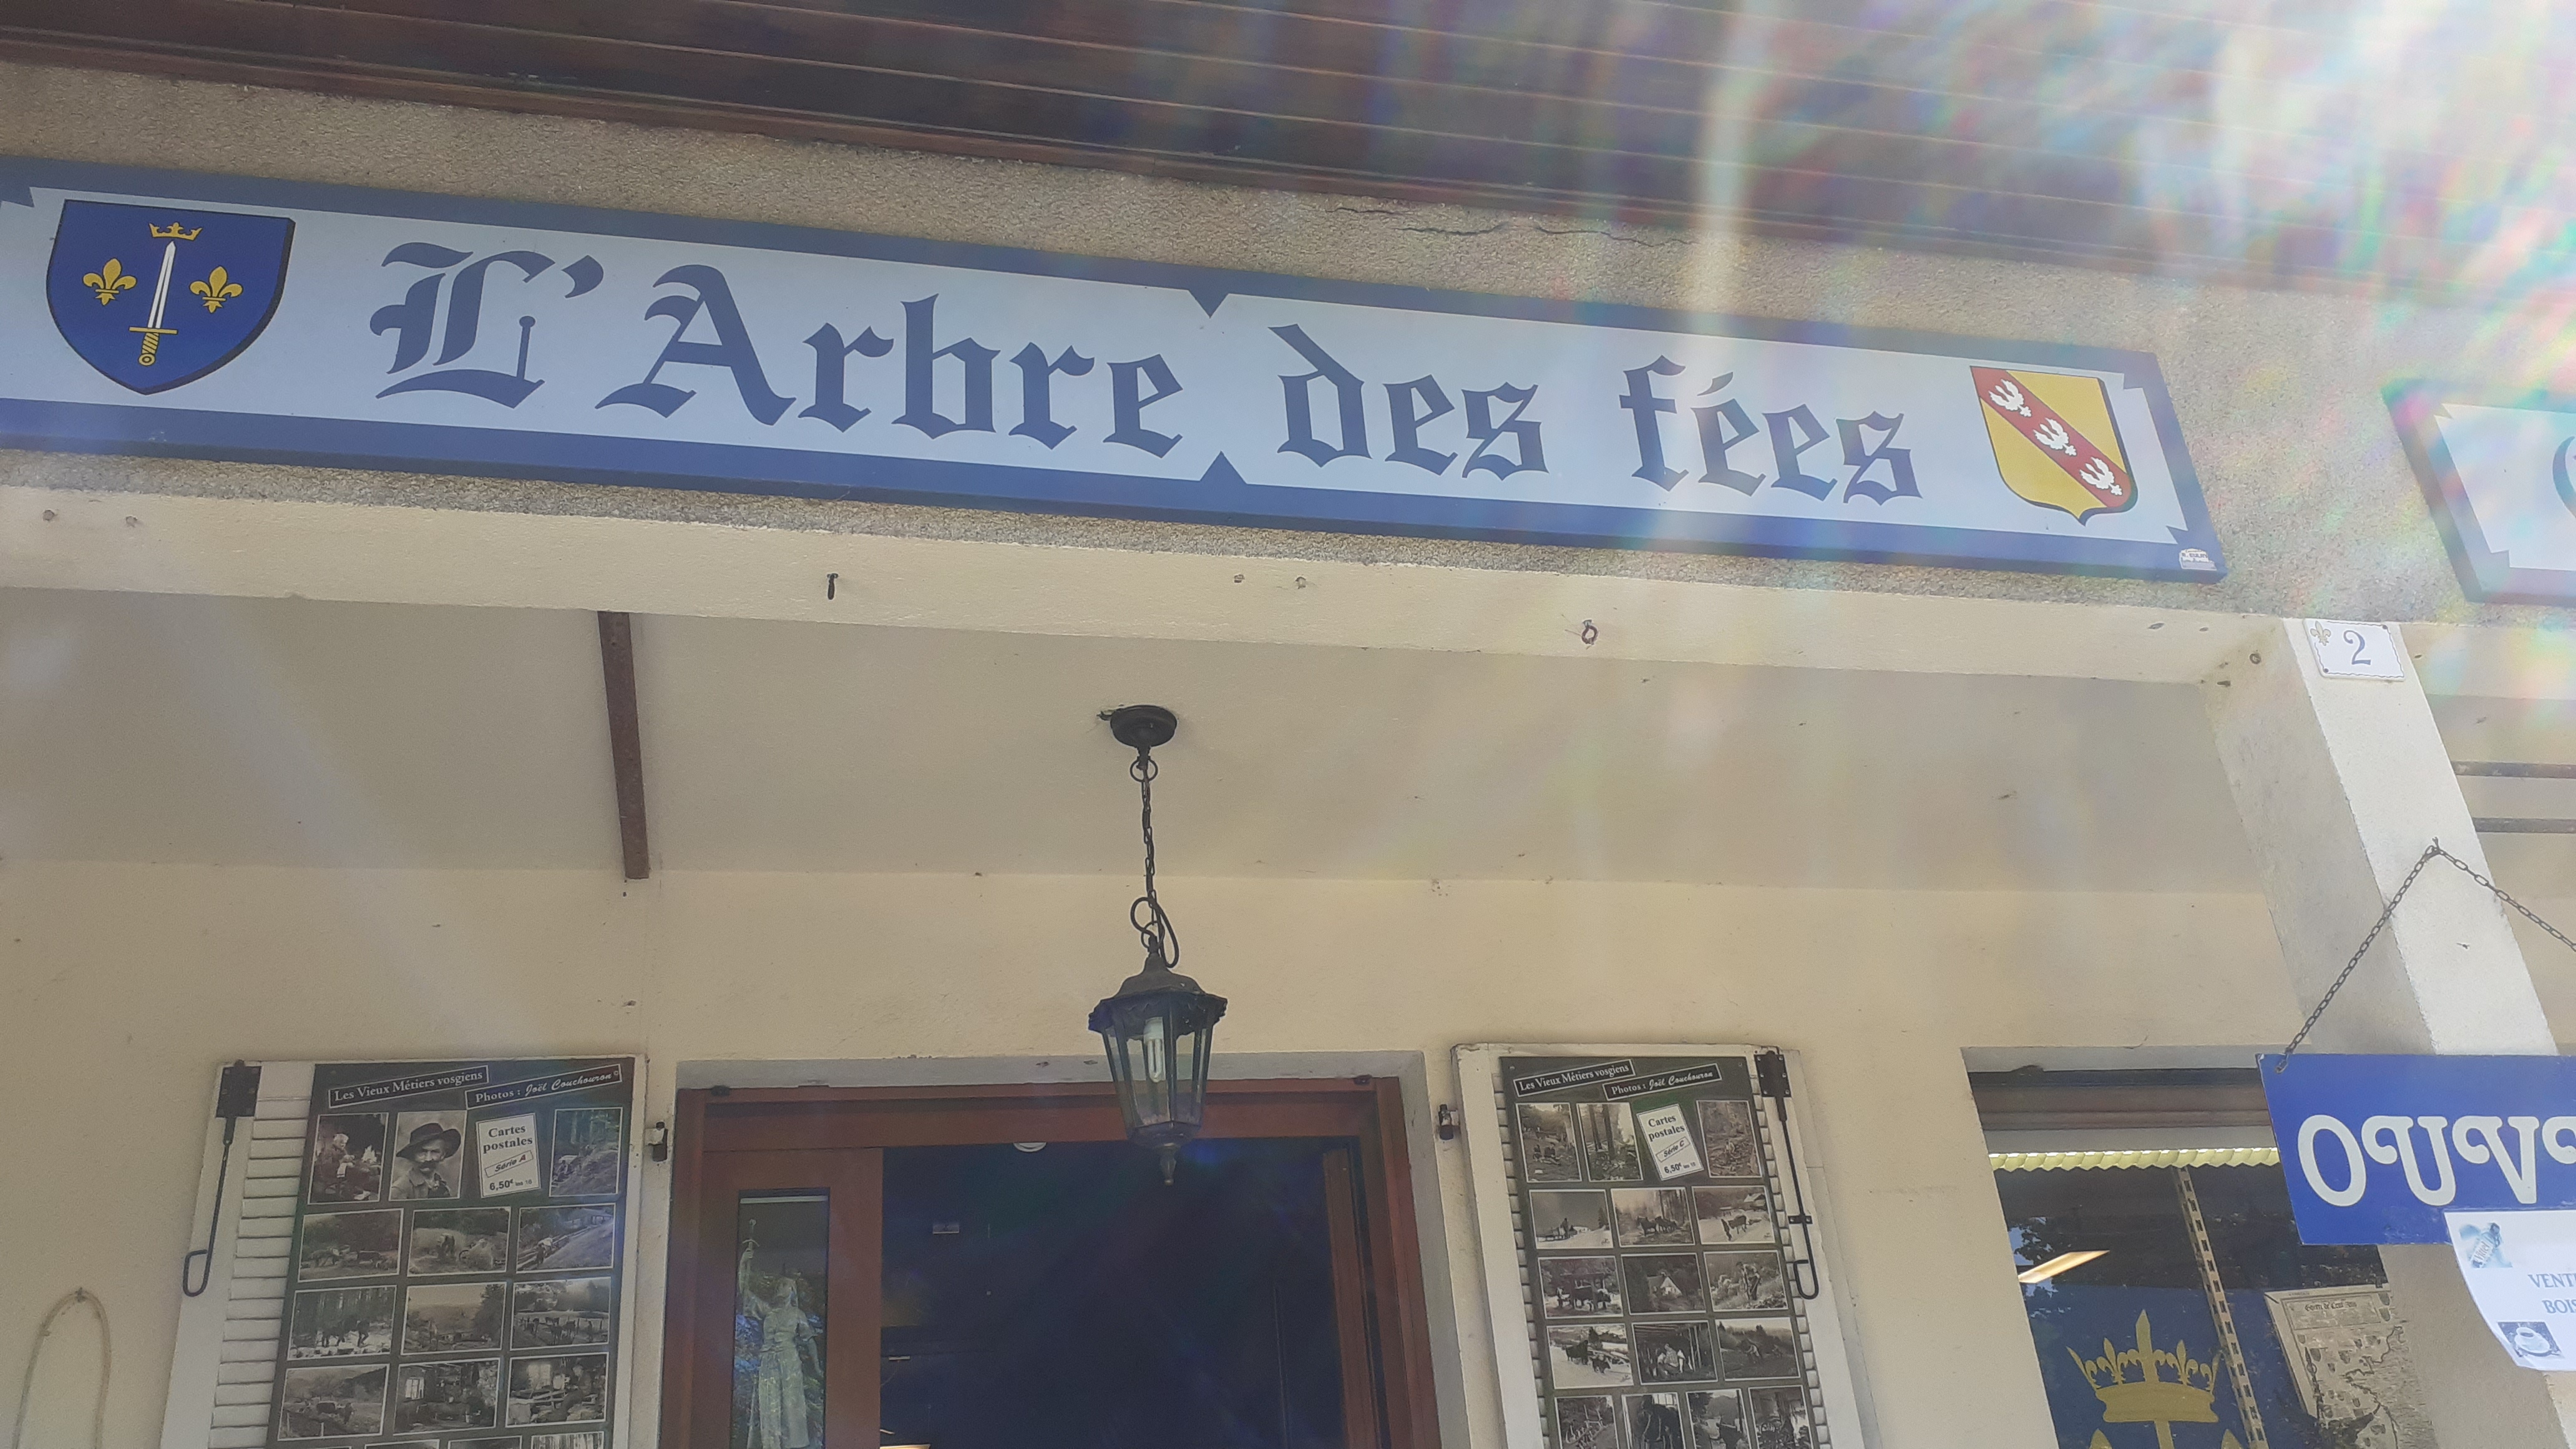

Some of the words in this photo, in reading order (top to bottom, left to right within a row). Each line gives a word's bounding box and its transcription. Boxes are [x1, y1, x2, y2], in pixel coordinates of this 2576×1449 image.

[370, 242, 1183, 459] L'Arbre
[1268, 324, 1549, 481] des
[1619, 355, 1923, 506] fées
[2343, 630, 2371, 665] 2
[334, 1090, 354, 1101] Les
[357, 1086, 390, 1097] Vieux
[393, 1079, 435, 1092] Métiers
[437, 1071, 483, 1086] vosgiens
[476, 1090, 514, 1103] Photos
[525, 1084, 547, 1096] Joël
[551, 1073, 612, 1091] Couchouron
[1519, 1081, 1535, 1091] Les
[1535, 1077, 1561, 1088] Vieux
[1561, 1071, 1594, 1083] Métiers
[1594, 1065, 1629, 1078] vosgiens
[1611, 1085, 1641, 1095] Photos
[1649, 1079, 1666, 1090] Joël
[1668, 1071, 1714, 1086] Couchouron
[489, 1126, 526, 1138] Cartes
[1648, 1115, 1676, 1127] Cartes
[483, 1137, 533, 1154] postales
[1648, 1125, 1685, 1142] postales
[2527, 1273, 2576, 1288] VENT
